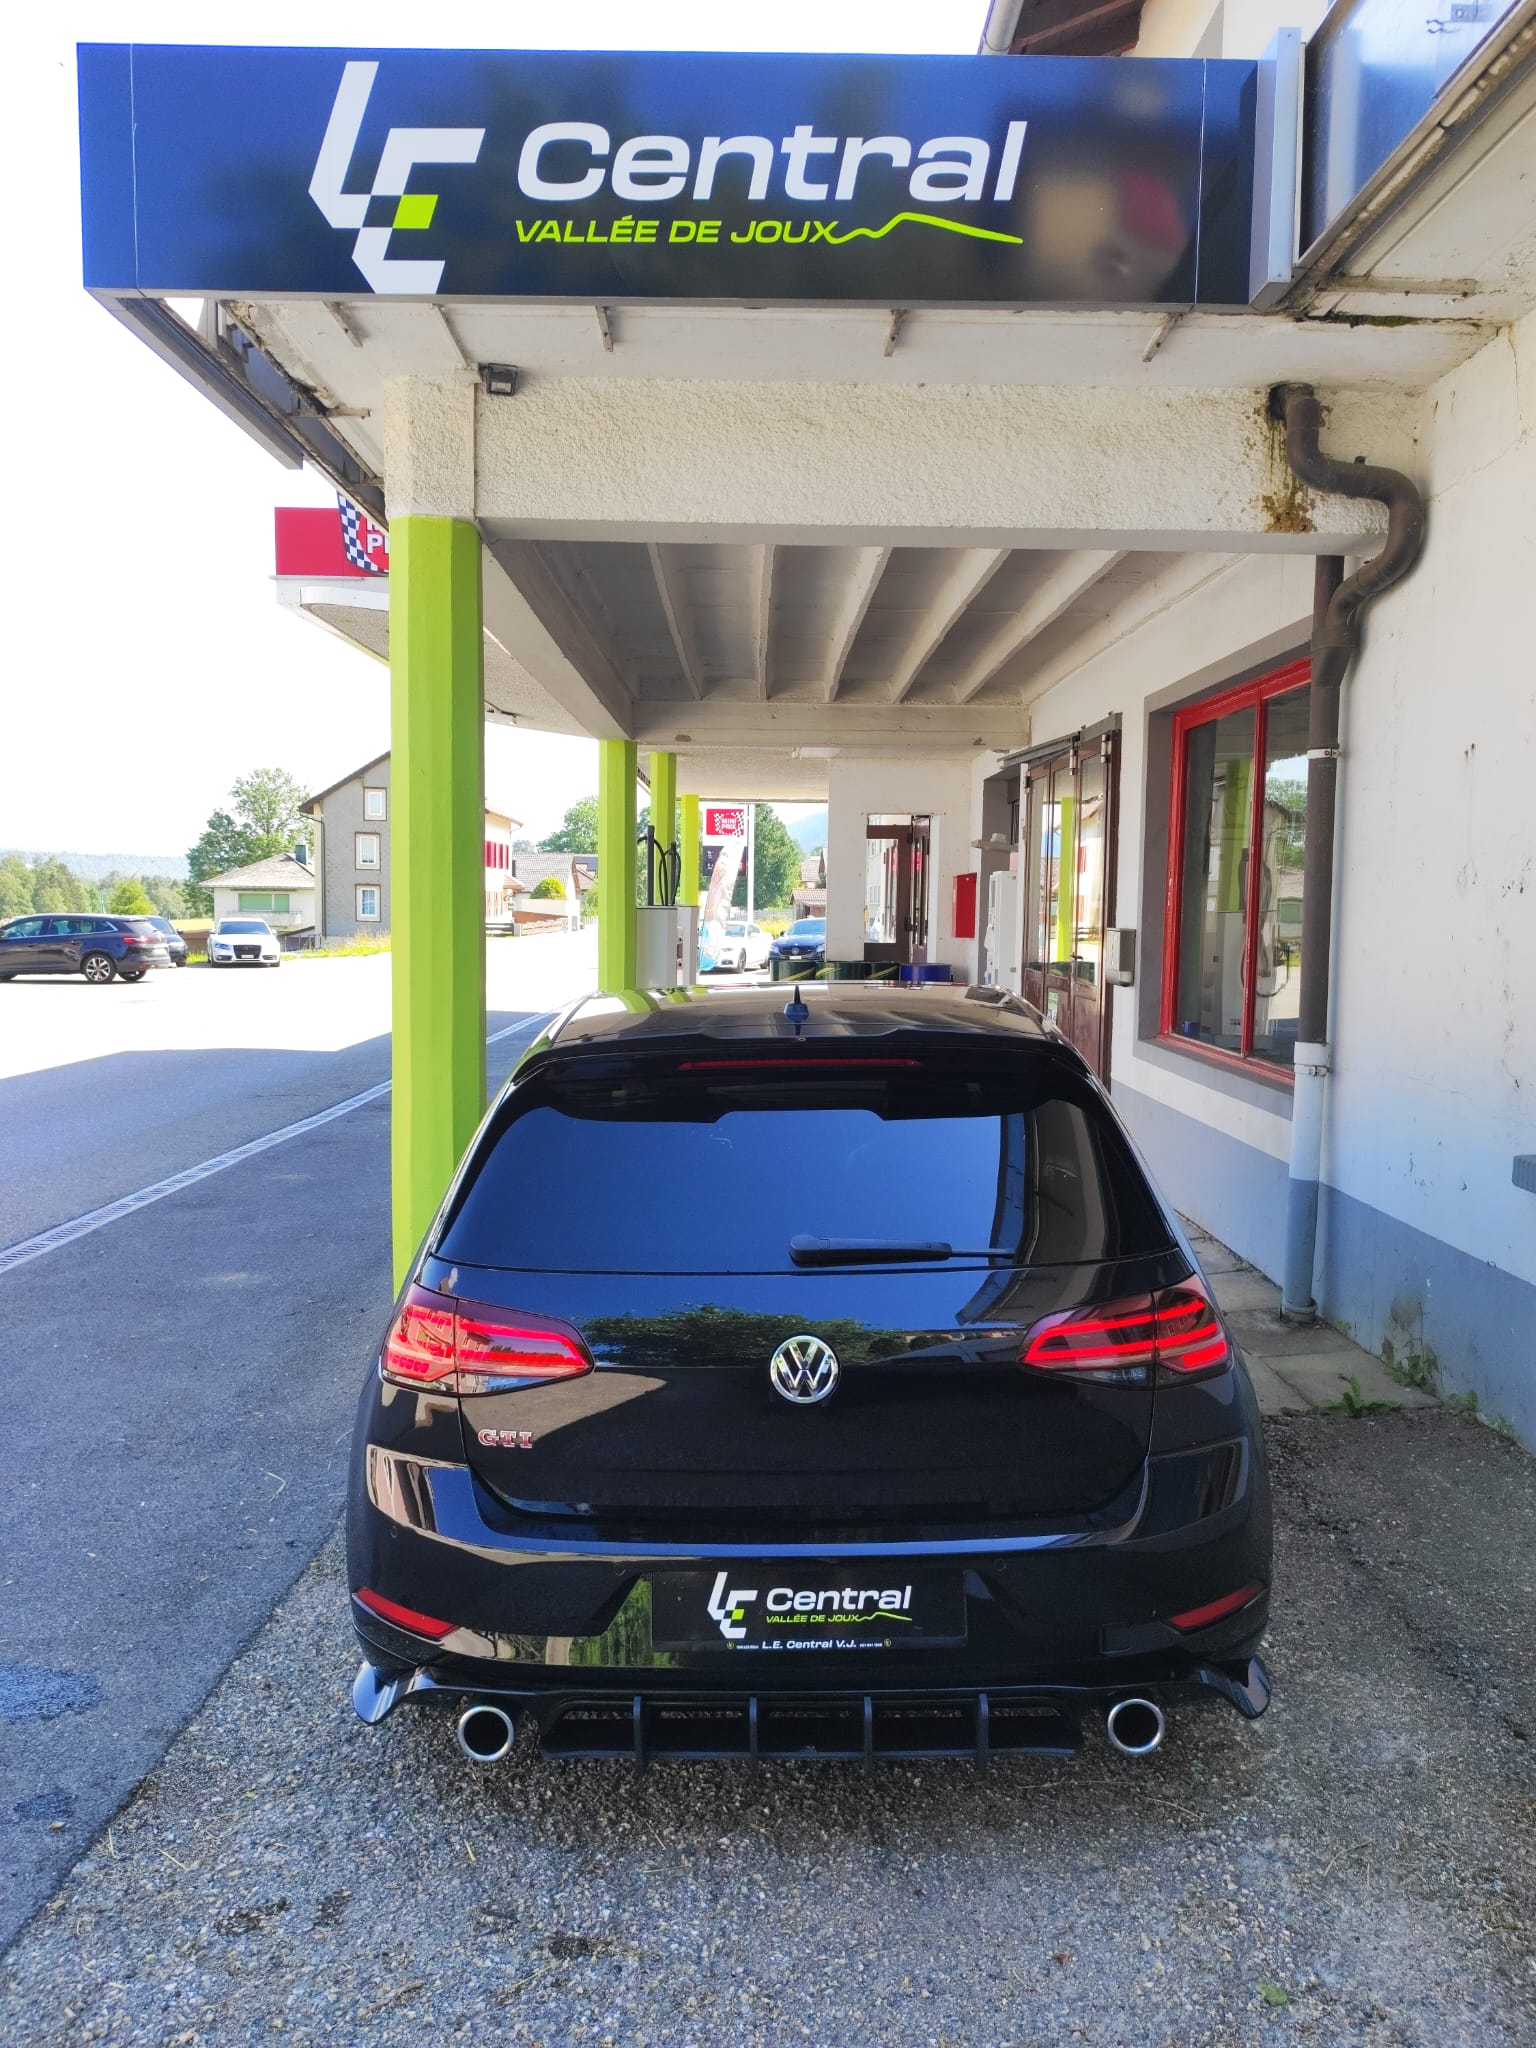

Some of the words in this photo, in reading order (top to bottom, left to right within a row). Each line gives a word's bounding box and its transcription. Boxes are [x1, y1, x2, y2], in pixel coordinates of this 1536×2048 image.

[517, 121, 1028, 202] Central
[515, 214, 660, 243] VALLÉE
[668, 220, 721, 243] DE
[730, 220, 839, 244] JOUX
[477, 1428, 533, 1449] GTI
[766, 1585, 912, 1612] Central
[766, 1613, 808, 1623] VALLÉE
[809, 1614, 826, 1623] DE
[827, 1614, 859, 1622] JOUX
[761, 1640, 784, 1649] L.E.
[786, 1640, 833, 1649] Central
[835, 1639, 857, 1648] V.J.
